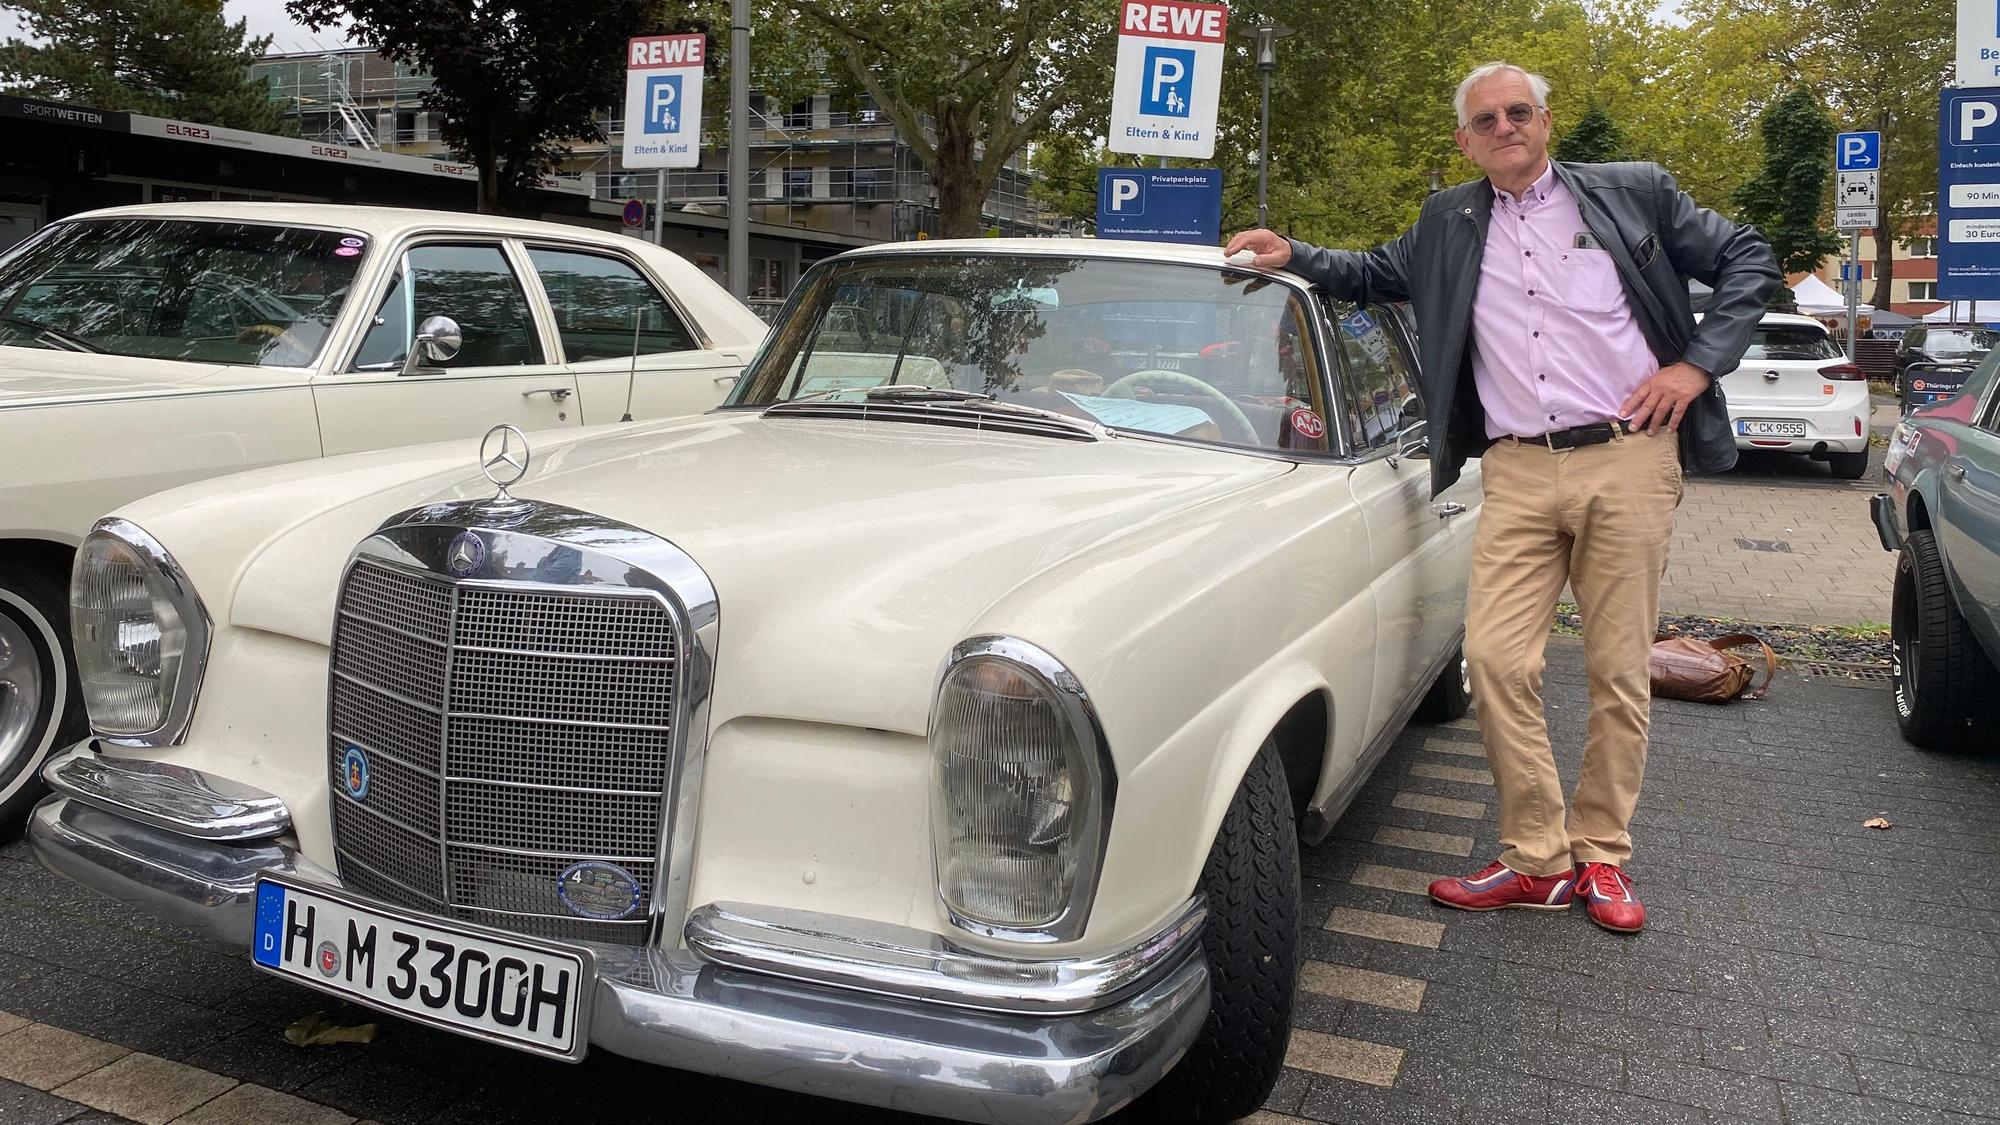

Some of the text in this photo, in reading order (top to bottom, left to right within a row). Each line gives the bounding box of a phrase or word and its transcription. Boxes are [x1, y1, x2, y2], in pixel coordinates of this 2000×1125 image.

[1125, 3, 1222, 38] REWE
[631, 38, 701, 66] REWE
[1151, 56, 1185, 103] P
[651, 83, 676, 123] P
[22, 103, 103, 125] SPORTWETTEN
[1960, 101, 1998, 141] P
[166, 124, 210, 140] ELA23
[1126, 126, 1200, 141] Eltern & Kind
[634, 144, 688, 154] Eltern & Kind
[1844, 137, 1867, 166] P
[1151, 175, 1207, 184] Privatparkplatz
[1112, 179, 1139, 211] P
[1967, 192, 1979, 200] 90
[1965, 230, 1978, 238] 30
[1745, 422, 1803, 434] K CK 9555
[571, 869, 582, 884] 4
[263, 933, 274, 951] D
[284, 899, 570, 1039] H M 3300H
